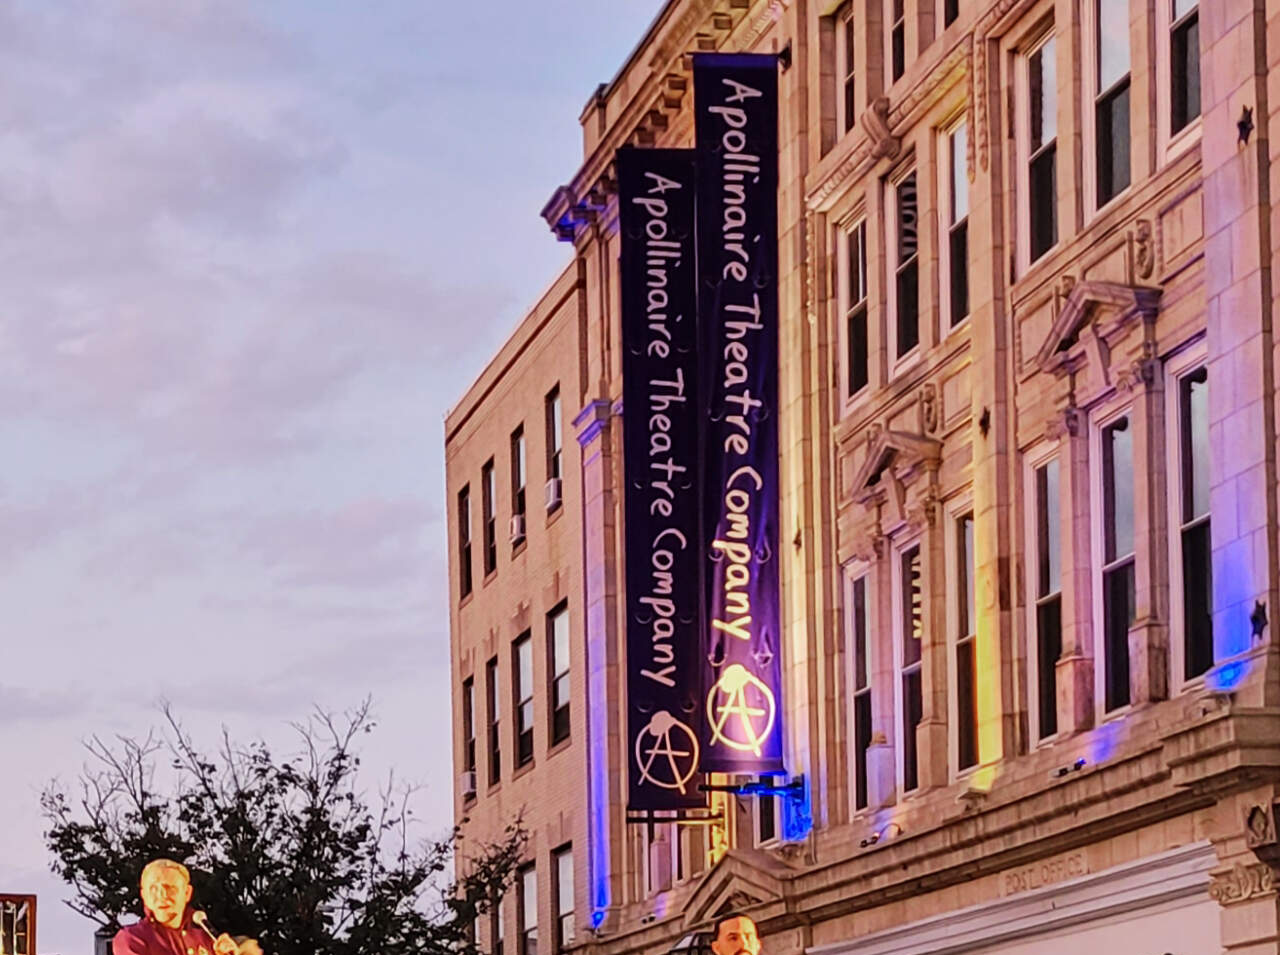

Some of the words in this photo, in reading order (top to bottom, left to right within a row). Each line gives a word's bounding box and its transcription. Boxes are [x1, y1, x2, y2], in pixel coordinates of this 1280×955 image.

[708, 77, 763, 283] Apollinaire
[632, 171, 683, 360] Apollinaire
[648, 367, 687, 518] Theatre
[723, 293, 765, 455] Theatre
[639, 527, 688, 688] Company
[711, 465, 763, 642] Company
